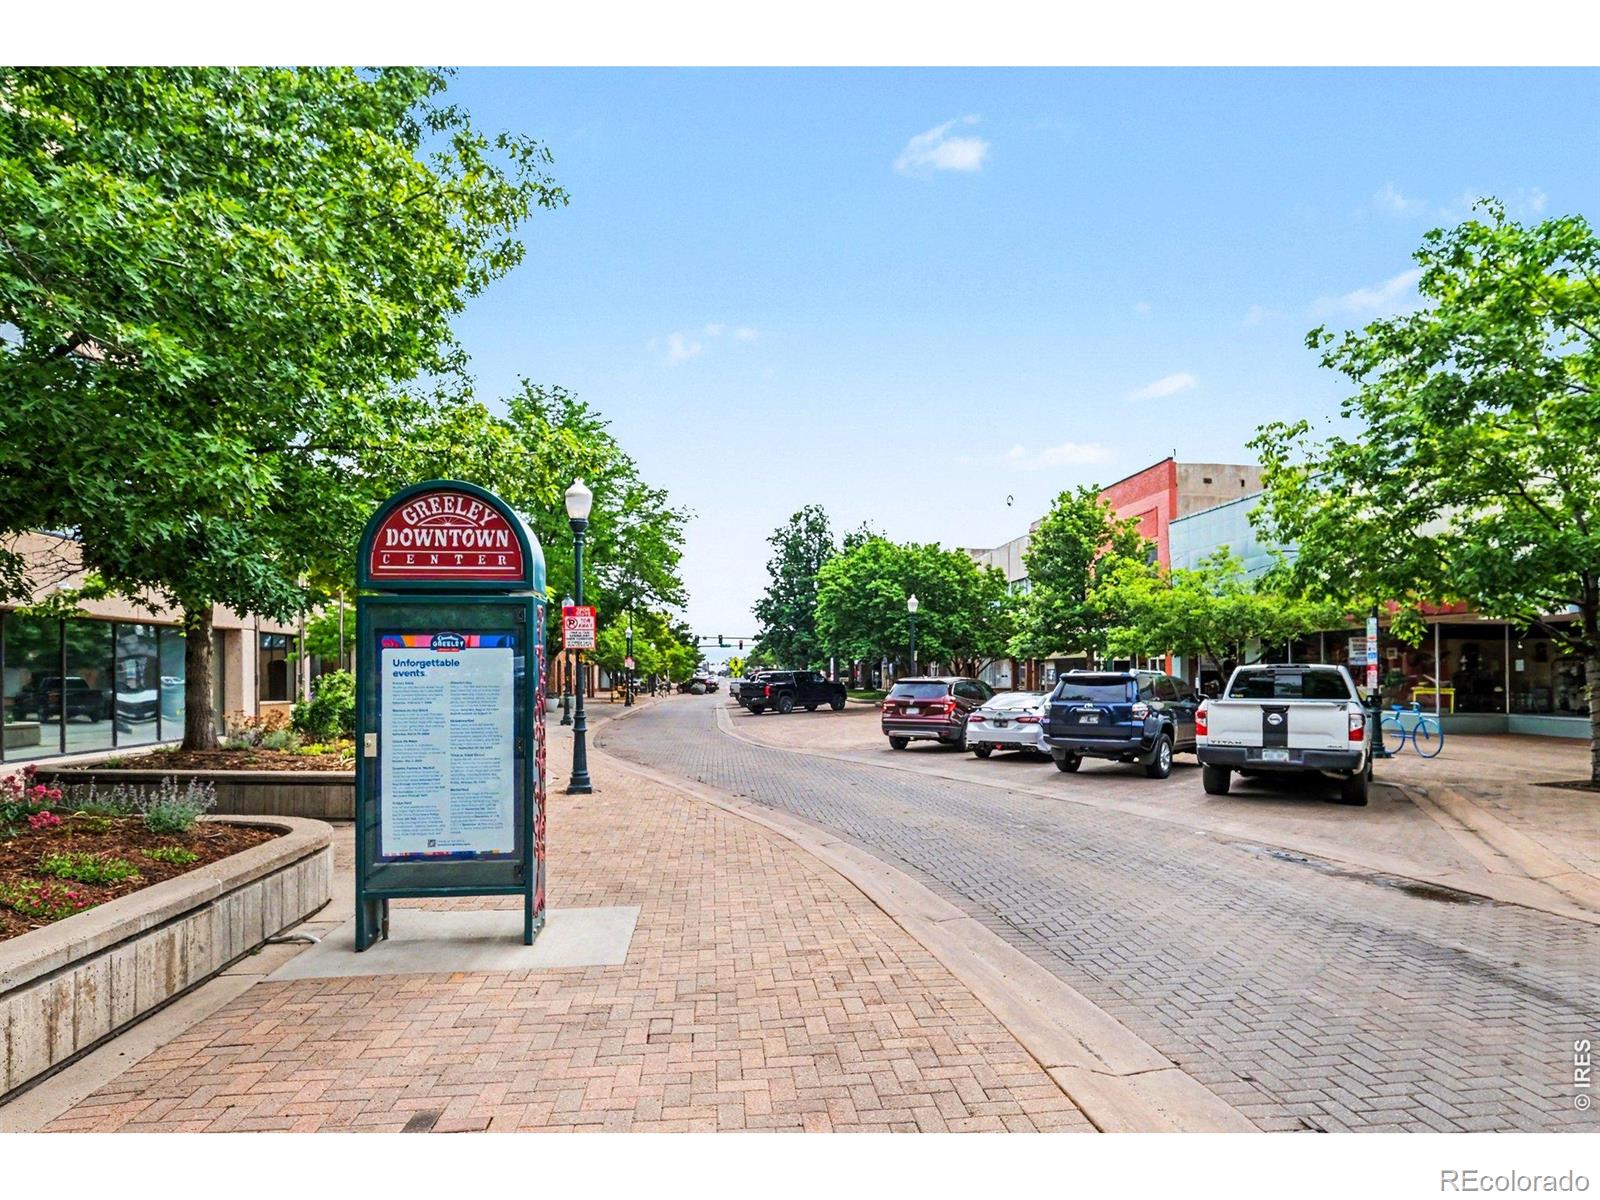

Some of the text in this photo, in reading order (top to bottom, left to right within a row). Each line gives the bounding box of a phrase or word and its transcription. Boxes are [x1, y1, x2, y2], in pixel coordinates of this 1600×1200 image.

[402, 496, 498, 526] GREELEY
[385, 528, 509, 547] DOWNTOWN
[383, 554, 507, 565] CENTER
[392, 659, 460, 669] Unforgettable
[392, 669, 425, 677] events
